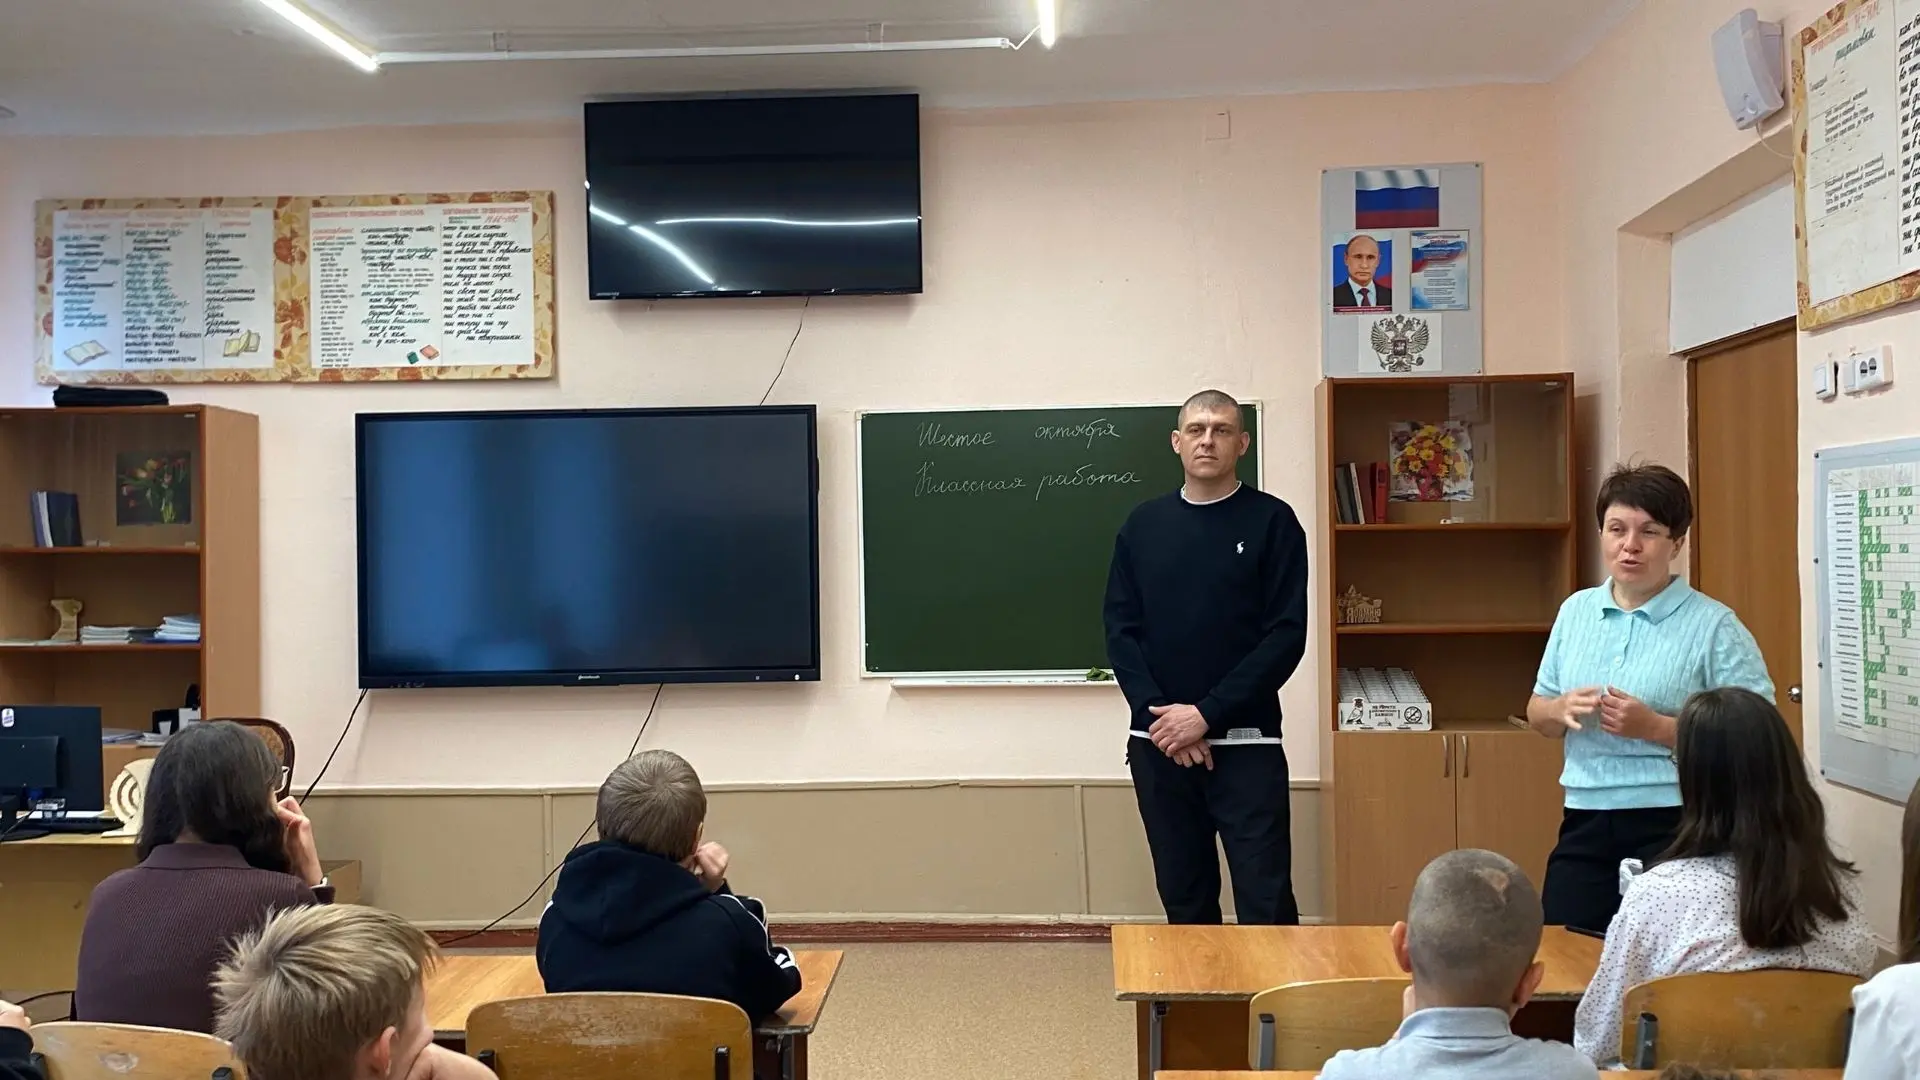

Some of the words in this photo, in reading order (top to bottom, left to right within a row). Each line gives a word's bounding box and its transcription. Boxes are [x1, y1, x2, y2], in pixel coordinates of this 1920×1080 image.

[455, 241, 477, 249] слуху
[493, 240, 514, 251] духу
[500, 246, 532, 258] привета
[457, 272, 477, 281] туда
[492, 272, 512, 281] сюда
[492, 288, 513, 297] заря
[369, 304, 398, 313] потому
[454, 304, 476, 314] рыба
[918, 422, 995, 447] Шестое
[1034, 418, 1121, 449] октября
[914, 461, 1027, 497] Классная
[1035, 463, 1142, 501] работа
